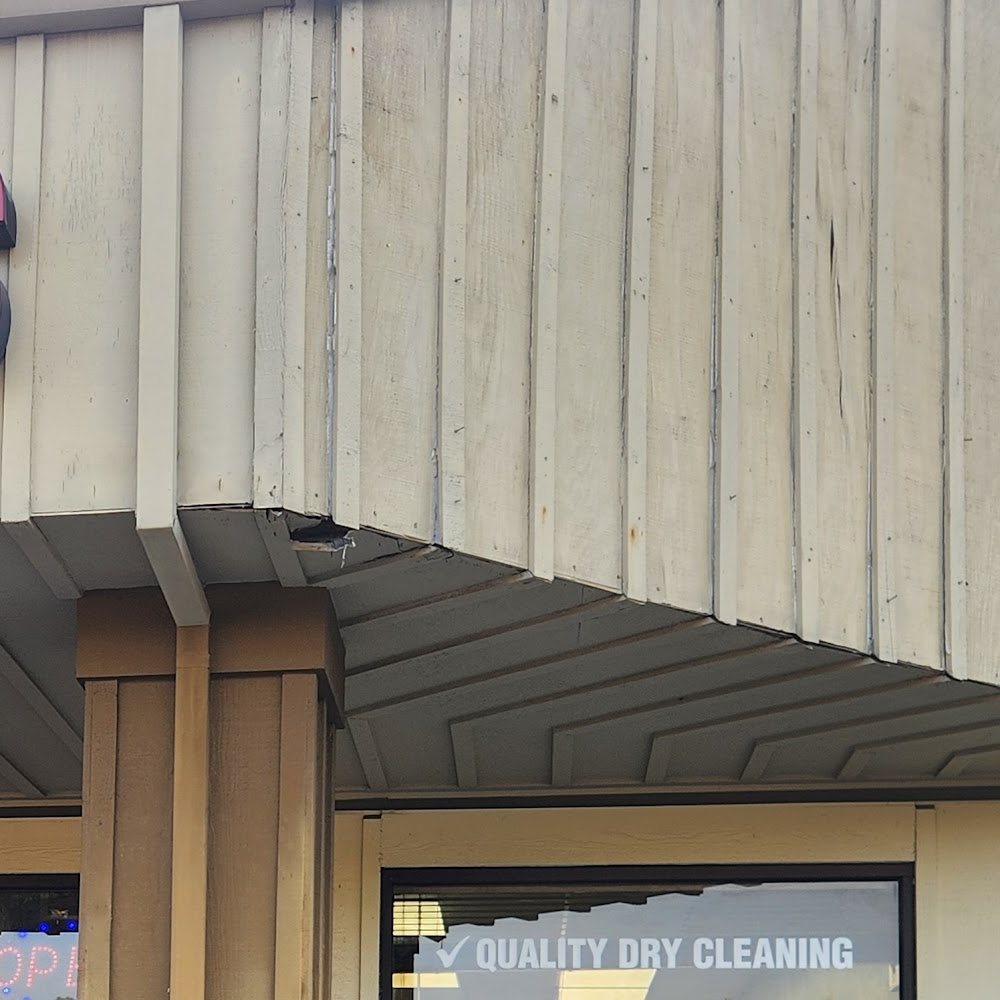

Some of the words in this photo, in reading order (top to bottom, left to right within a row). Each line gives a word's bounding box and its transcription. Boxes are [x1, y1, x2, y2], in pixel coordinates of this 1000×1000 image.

[475, 937, 607, 973] QUALITY
[618, 938, 682, 970] DRY
[692, 937, 854, 970] CLEANING
